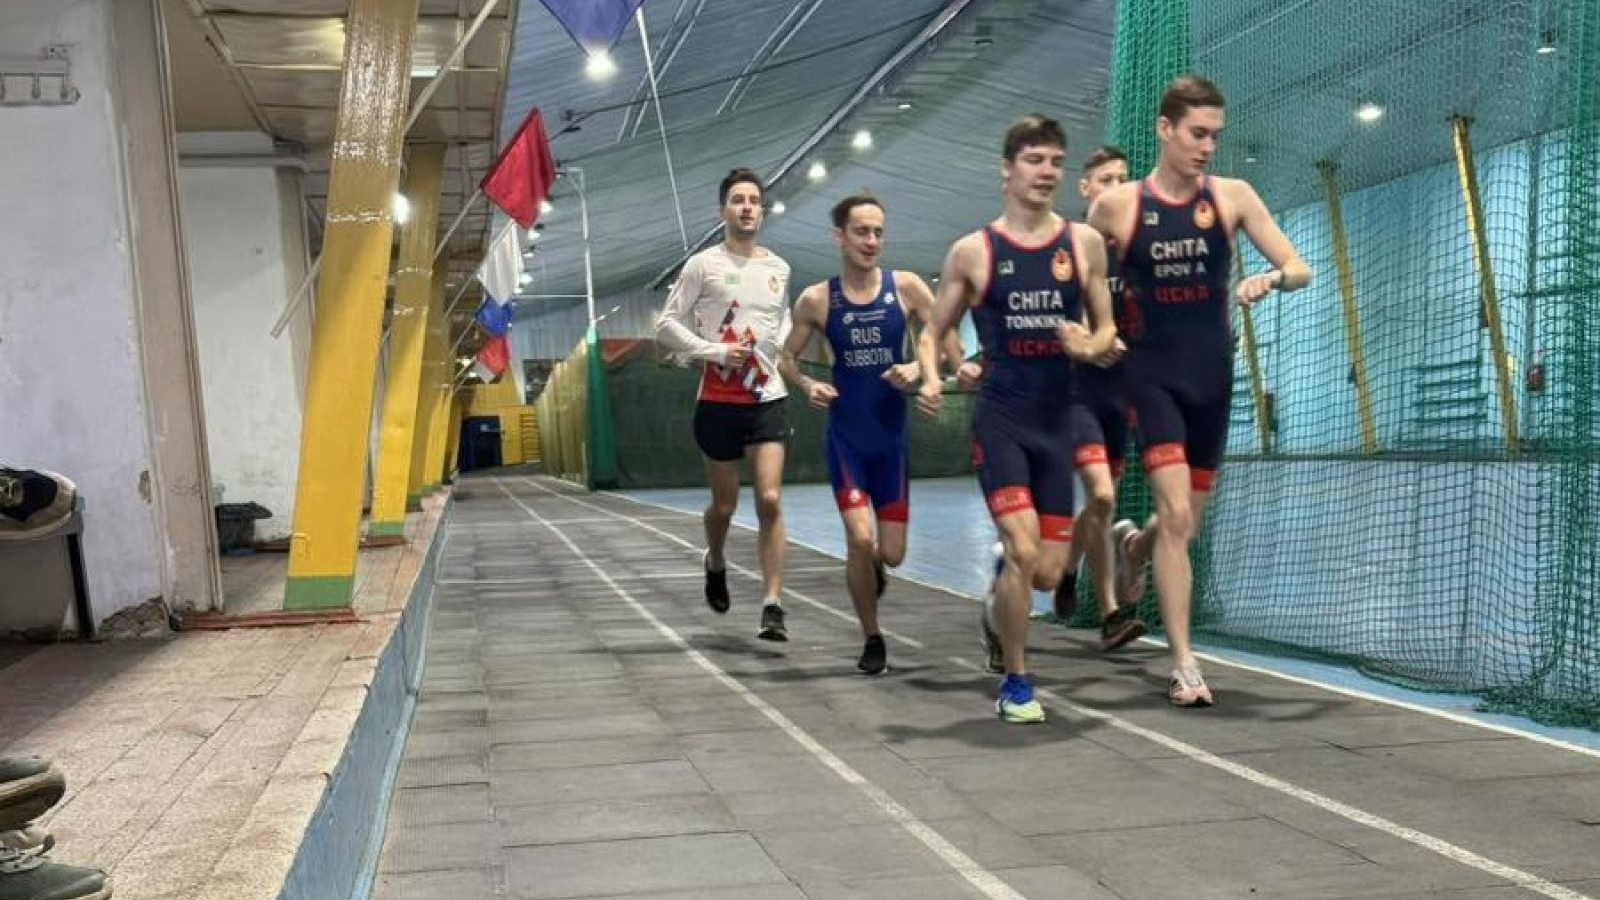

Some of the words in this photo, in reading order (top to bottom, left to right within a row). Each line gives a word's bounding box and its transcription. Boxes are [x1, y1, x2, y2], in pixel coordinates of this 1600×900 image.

[1151, 238, 1209, 260] CHITA
[1154, 263, 1191, 277] EPOV
[1008, 290, 1063, 310] CHITA
[851, 327, 881, 346] RUS
[844, 349, 893, 367] SUBBOTIN
